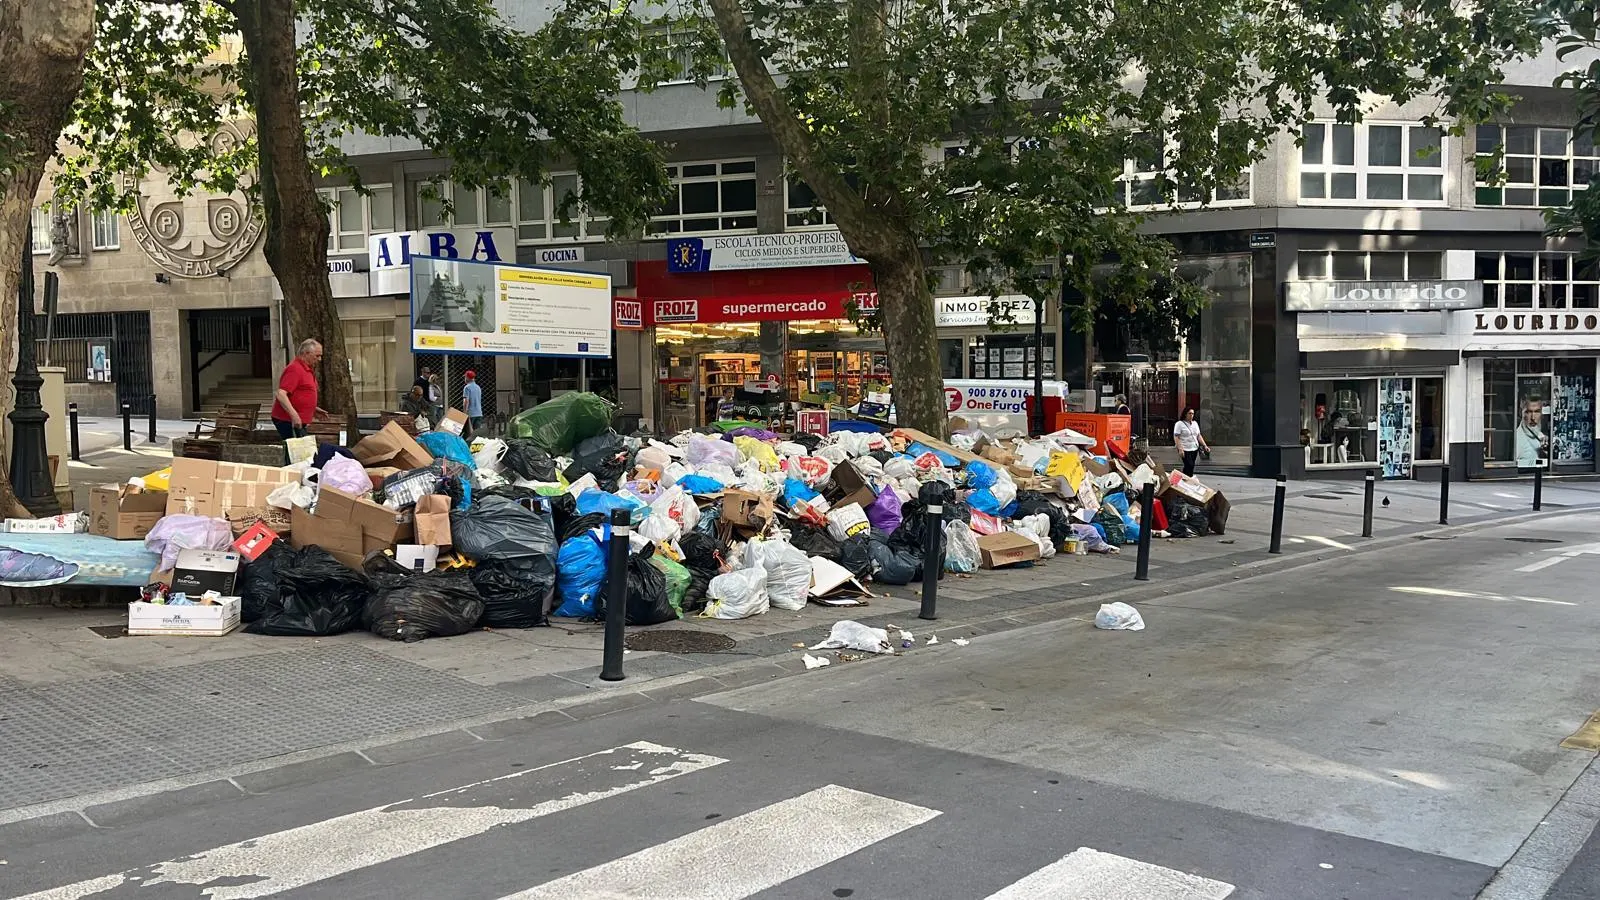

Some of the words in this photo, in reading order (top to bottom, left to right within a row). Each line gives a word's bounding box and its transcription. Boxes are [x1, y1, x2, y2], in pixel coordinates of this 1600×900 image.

[715, 237, 751, 249] ESCOLA
[541, 249, 578, 262] COCINA
[734, 248, 761, 258] CICLOS
[762, 247, 793, 257] MEDIOS
[794, 246, 799, 256] E
[800, 244, 846, 256] SUPERIORES
[184, 260, 213, 275] PAX
[1326, 284, 1467, 301] Lourido
[616, 302, 640, 319] FROIZ
[655, 301, 695, 316] FROIZ
[722, 298, 827, 316] supermercado
[1475, 314, 1597, 330] LOURIDO
[968, 388, 988, 397] 900
[989, 388, 1007, 397] 876
[1010, 388, 1028, 398] 016
